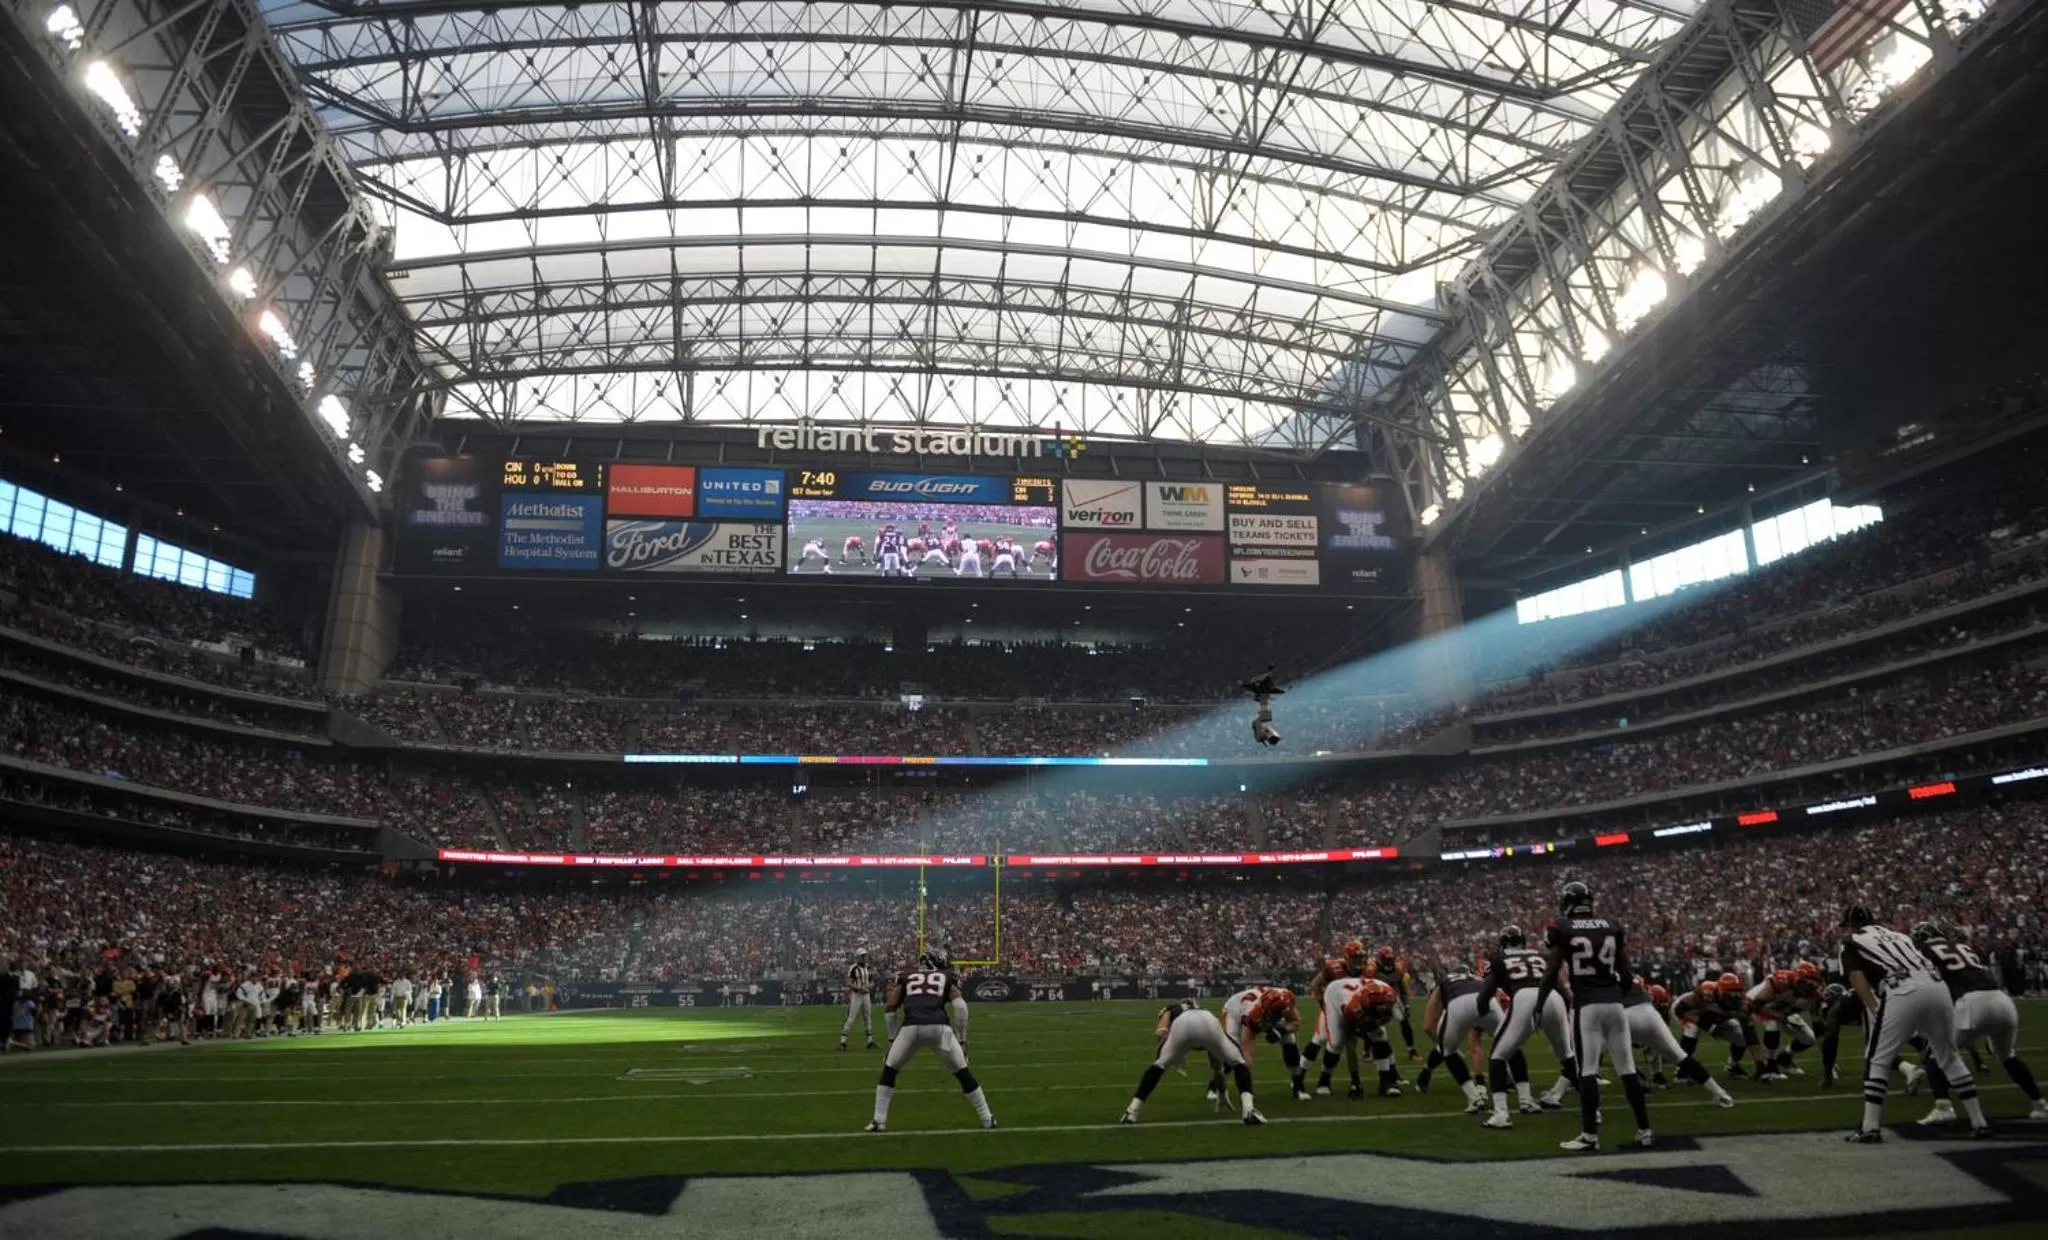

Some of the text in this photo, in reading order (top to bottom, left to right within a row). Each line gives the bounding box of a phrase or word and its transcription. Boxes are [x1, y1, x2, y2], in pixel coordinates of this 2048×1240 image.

[757, 420, 1042, 458] reliant stadium
[504, 462, 523, 473] CIN
[503, 474, 527, 485] HOU
[801, 471, 836, 486] 7:40
[611, 485, 693, 496] HALLIBURTON
[702, 481, 763, 492] UNITED
[869, 479, 980, 495] BUD LIGHT
[1159, 485, 1210, 501] WM
[437, 498, 465, 510] THE
[506, 503, 585, 518] Methodist
[1068, 507, 1135, 524] verizon
[755, 525, 777, 535] THE
[1232, 518, 1315, 530] BUY AND SELL
[505, 532, 584, 545] The Methodist
[729, 535, 776, 550] BEST
[1232, 531, 1316, 541] TEXANS TICKETS
[607, 521, 692, 568] Ford
[504, 546, 598, 560] Hospital System
[701, 550, 776, 566] IN TEXAS
[1084, 536, 1203, 580] Coca-Cola
[1909, 781, 1957, 799] TOSHIBA
[1571, 919, 1610, 929] JOSEPH
[1570, 936, 1618, 976] 24
[1930, 943, 1989, 972] 56
[906, 972, 947, 997] 29
[678, 994, 695, 1007] 55
